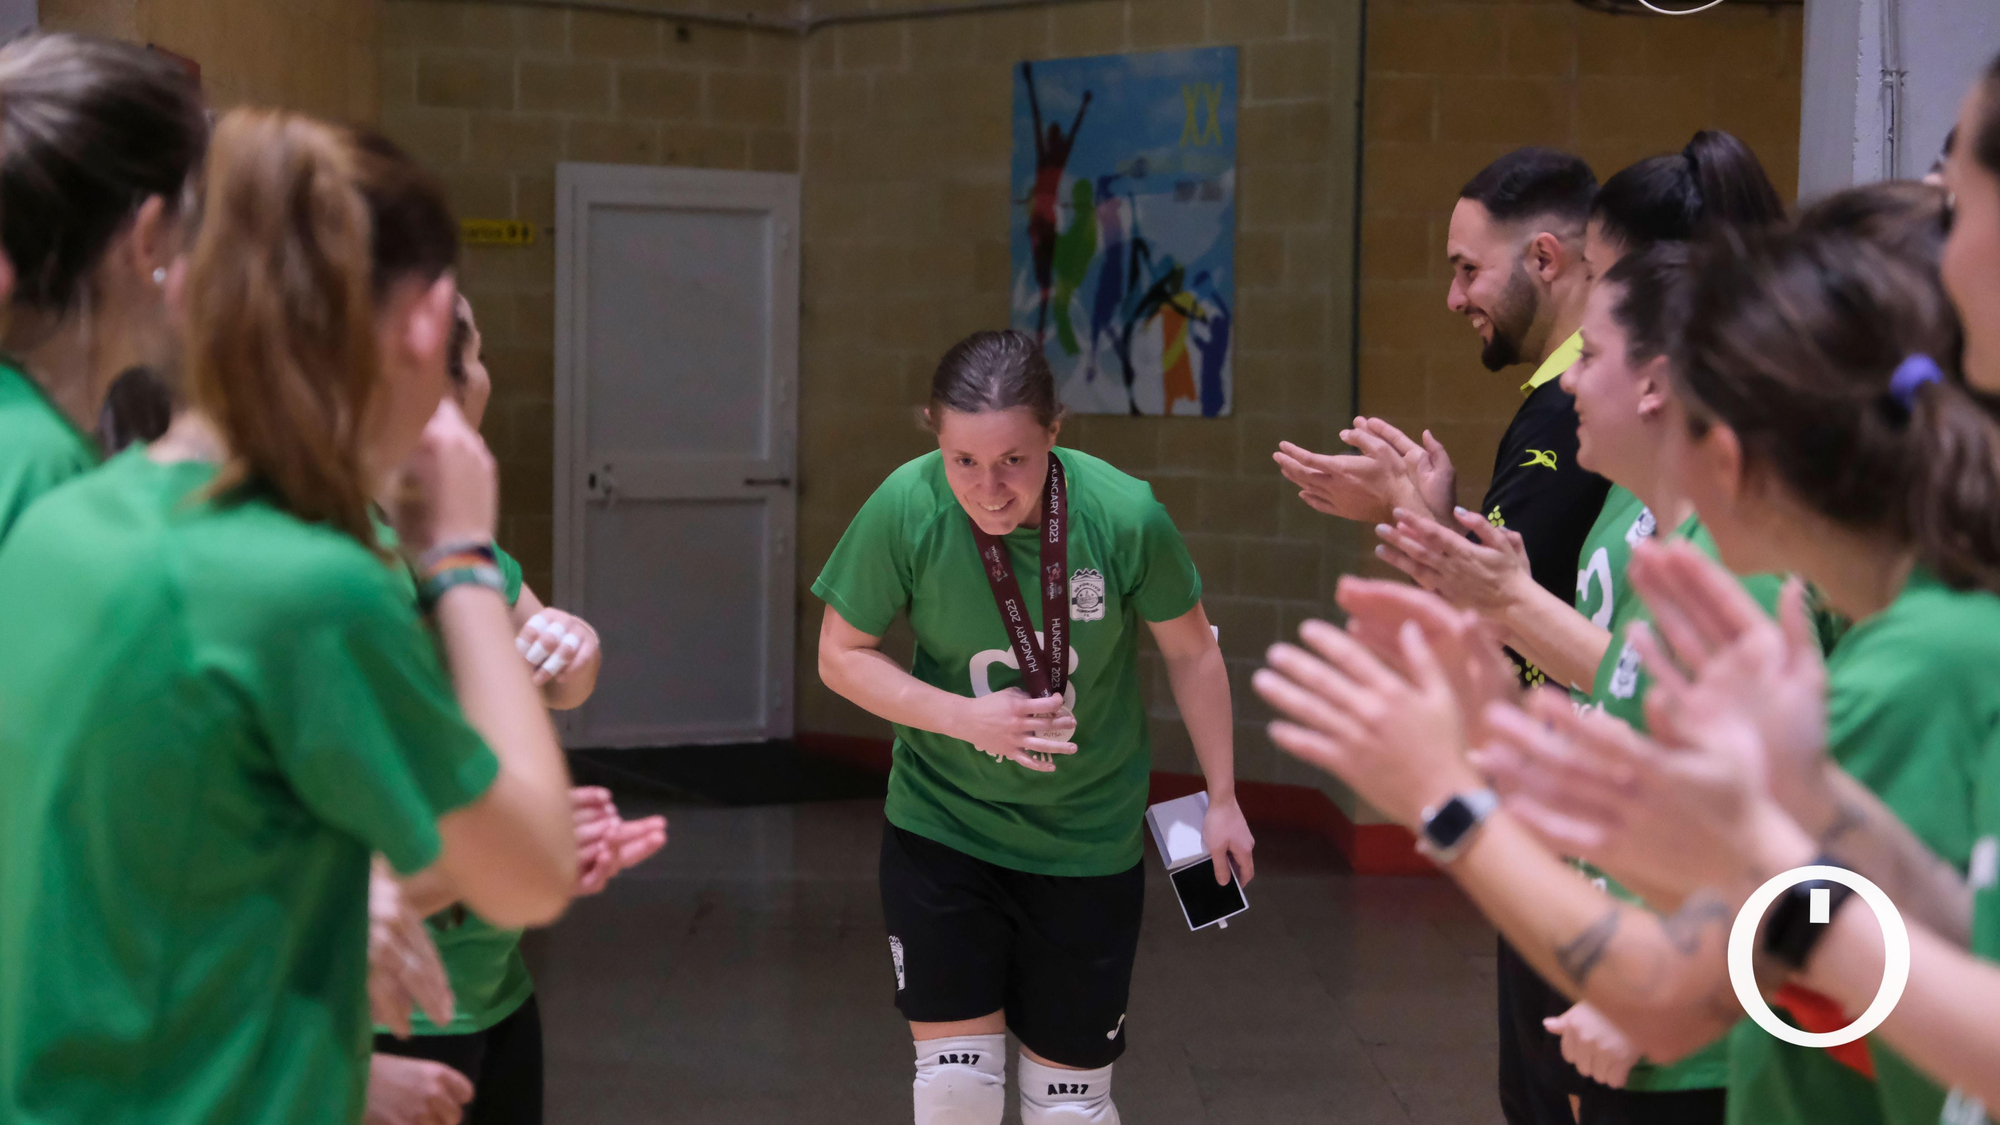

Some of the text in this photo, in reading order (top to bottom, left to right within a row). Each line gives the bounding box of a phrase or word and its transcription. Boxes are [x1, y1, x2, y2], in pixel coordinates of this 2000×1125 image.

[1179, 81, 1223, 147] XX
[1049, 464, 1059, 544] HUNGARY 2023
[1005, 598, 1039, 673] HUNGARY 2023
[1051, 617, 1062, 689] HUNGARY 2023
[939, 1053, 980, 1065] AR27
[1048, 1083, 1089, 1095] AR27
